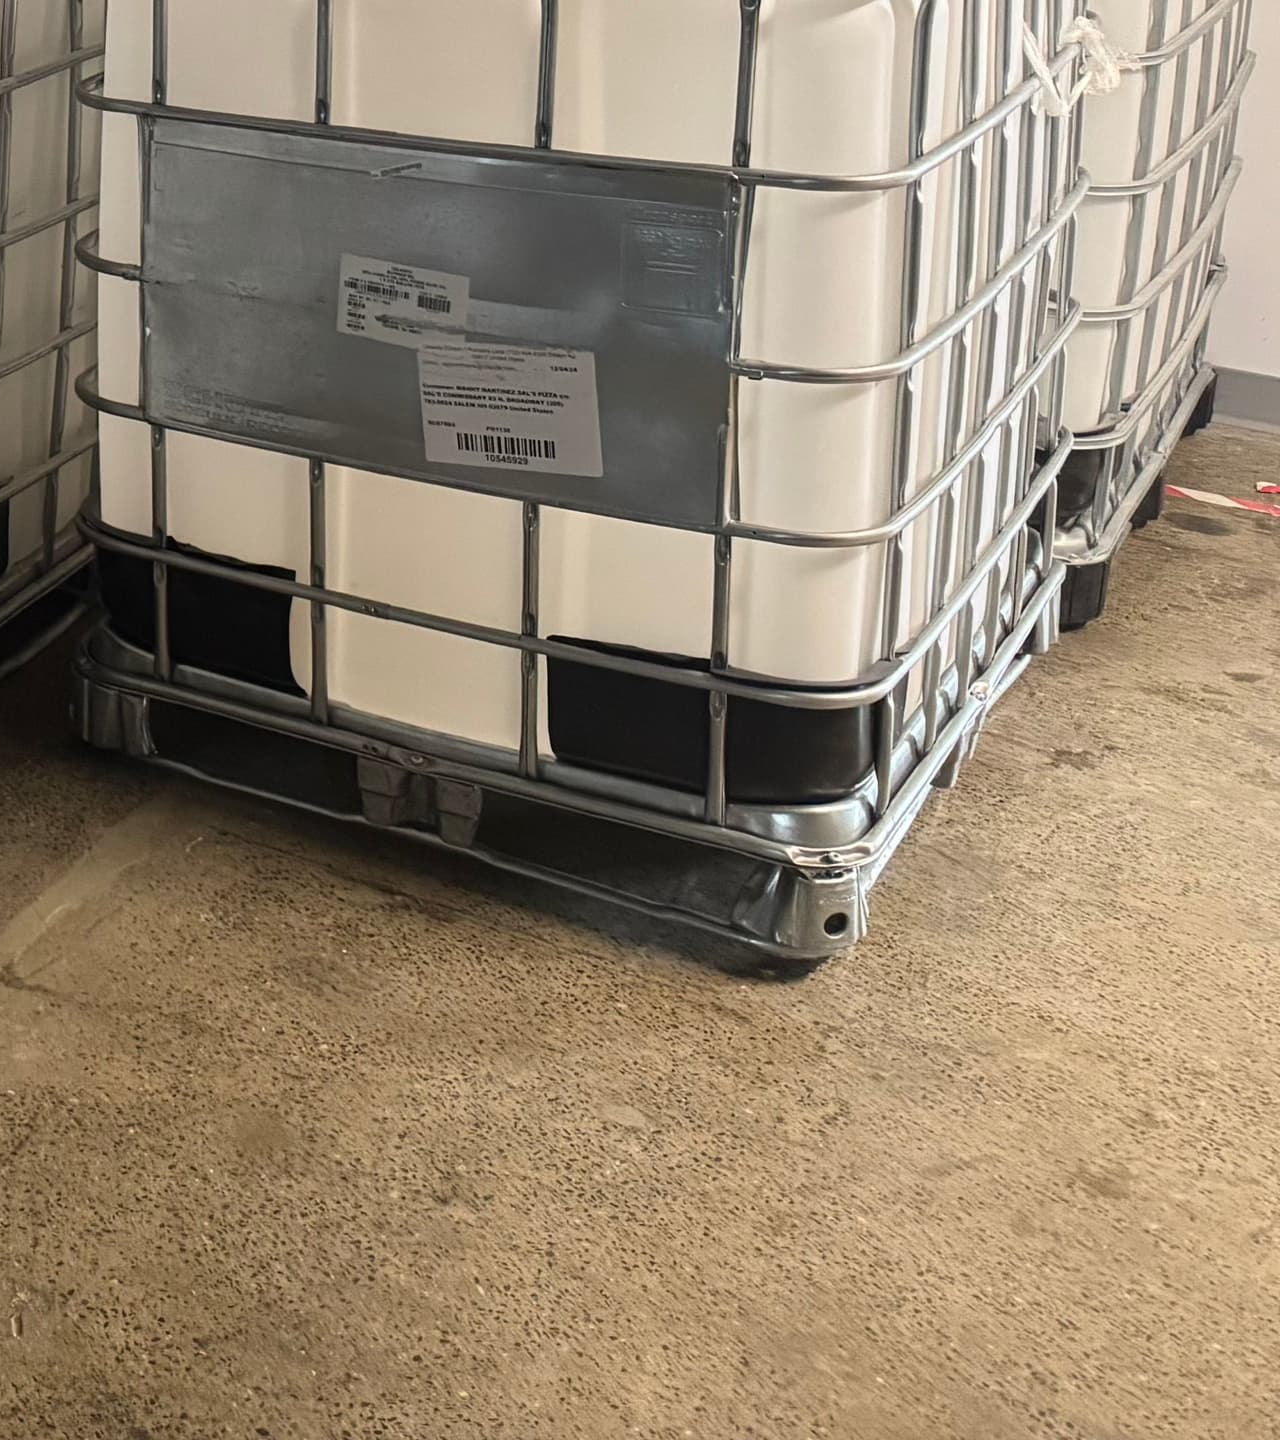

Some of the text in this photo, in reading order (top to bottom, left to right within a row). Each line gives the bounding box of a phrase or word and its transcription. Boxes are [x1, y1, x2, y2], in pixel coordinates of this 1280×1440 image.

[481, 387, 515, 395] MARTINEZ
[506, 397, 545, 405] BROADWAY
[509, 405, 531, 413] United
[485, 454, 529, 465] 10545929
